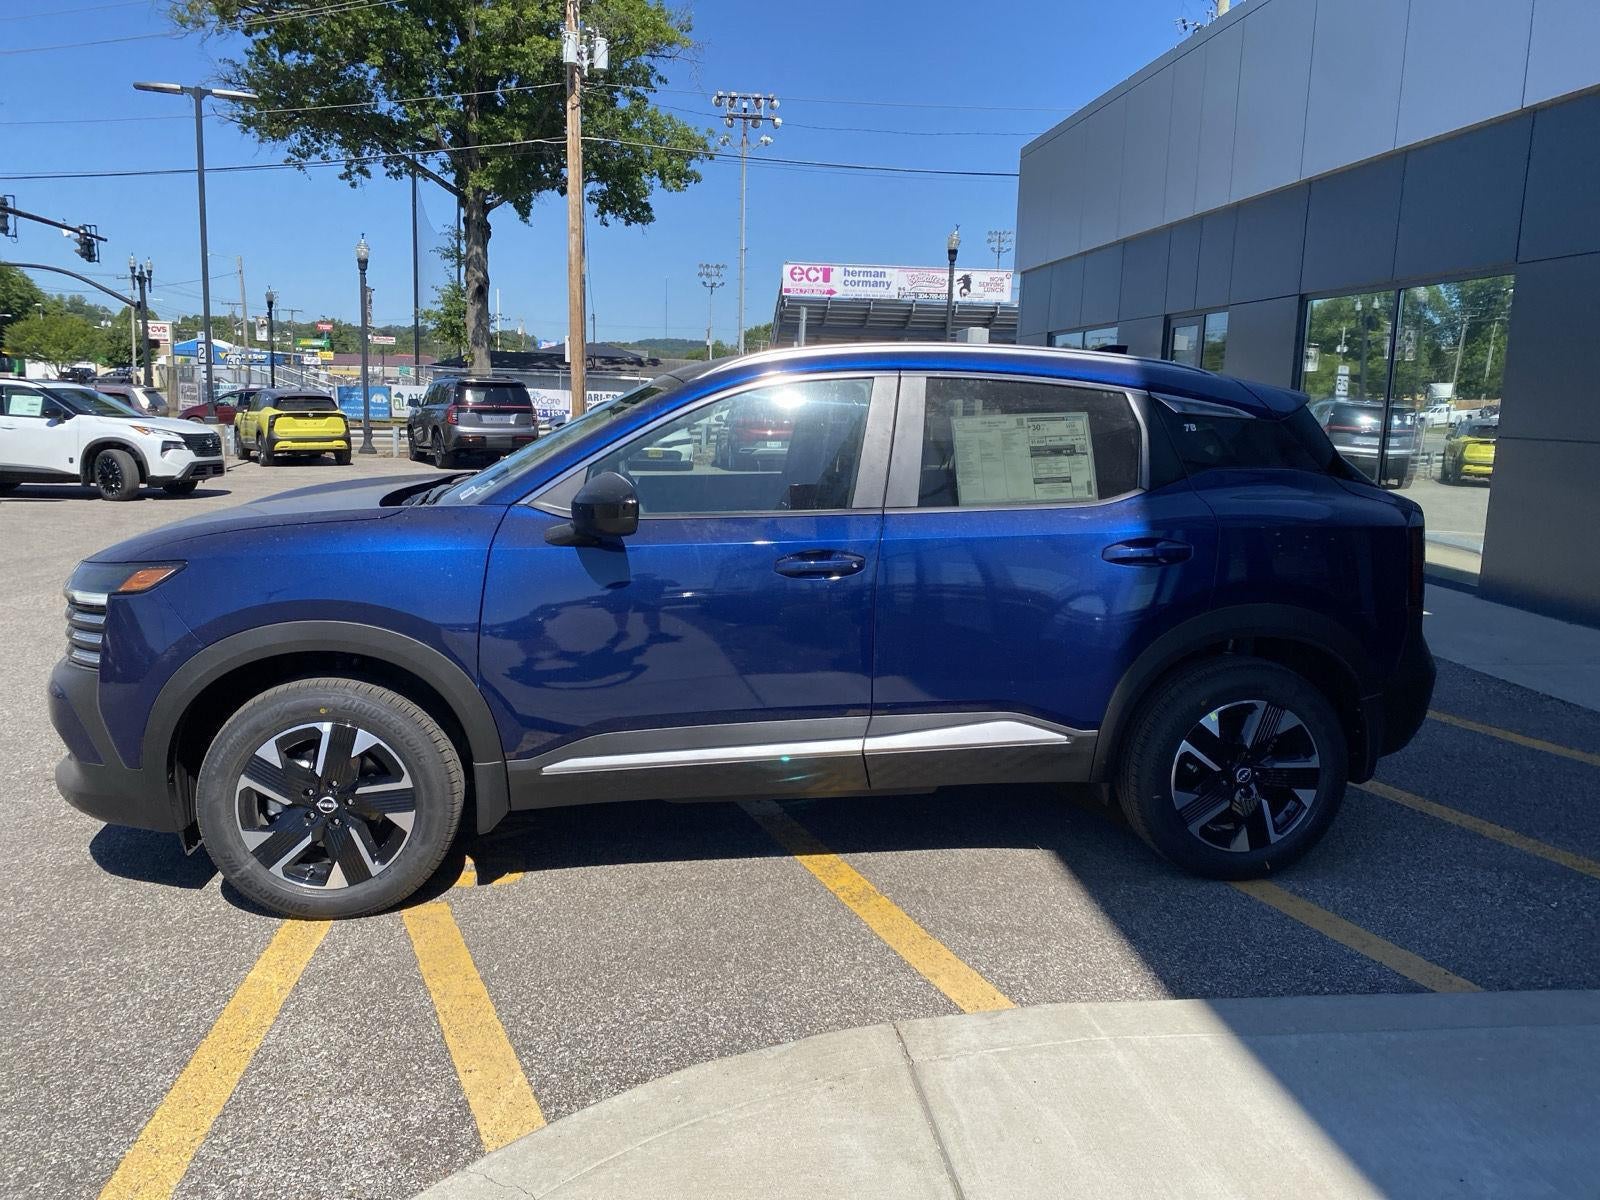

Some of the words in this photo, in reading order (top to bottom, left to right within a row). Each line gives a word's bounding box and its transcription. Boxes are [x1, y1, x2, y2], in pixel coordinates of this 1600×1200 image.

[843, 267, 886, 278] herman
[843, 279, 892, 290] cormany
[151, 325, 167, 333] CVS
[533, 395, 561, 406] yCare
